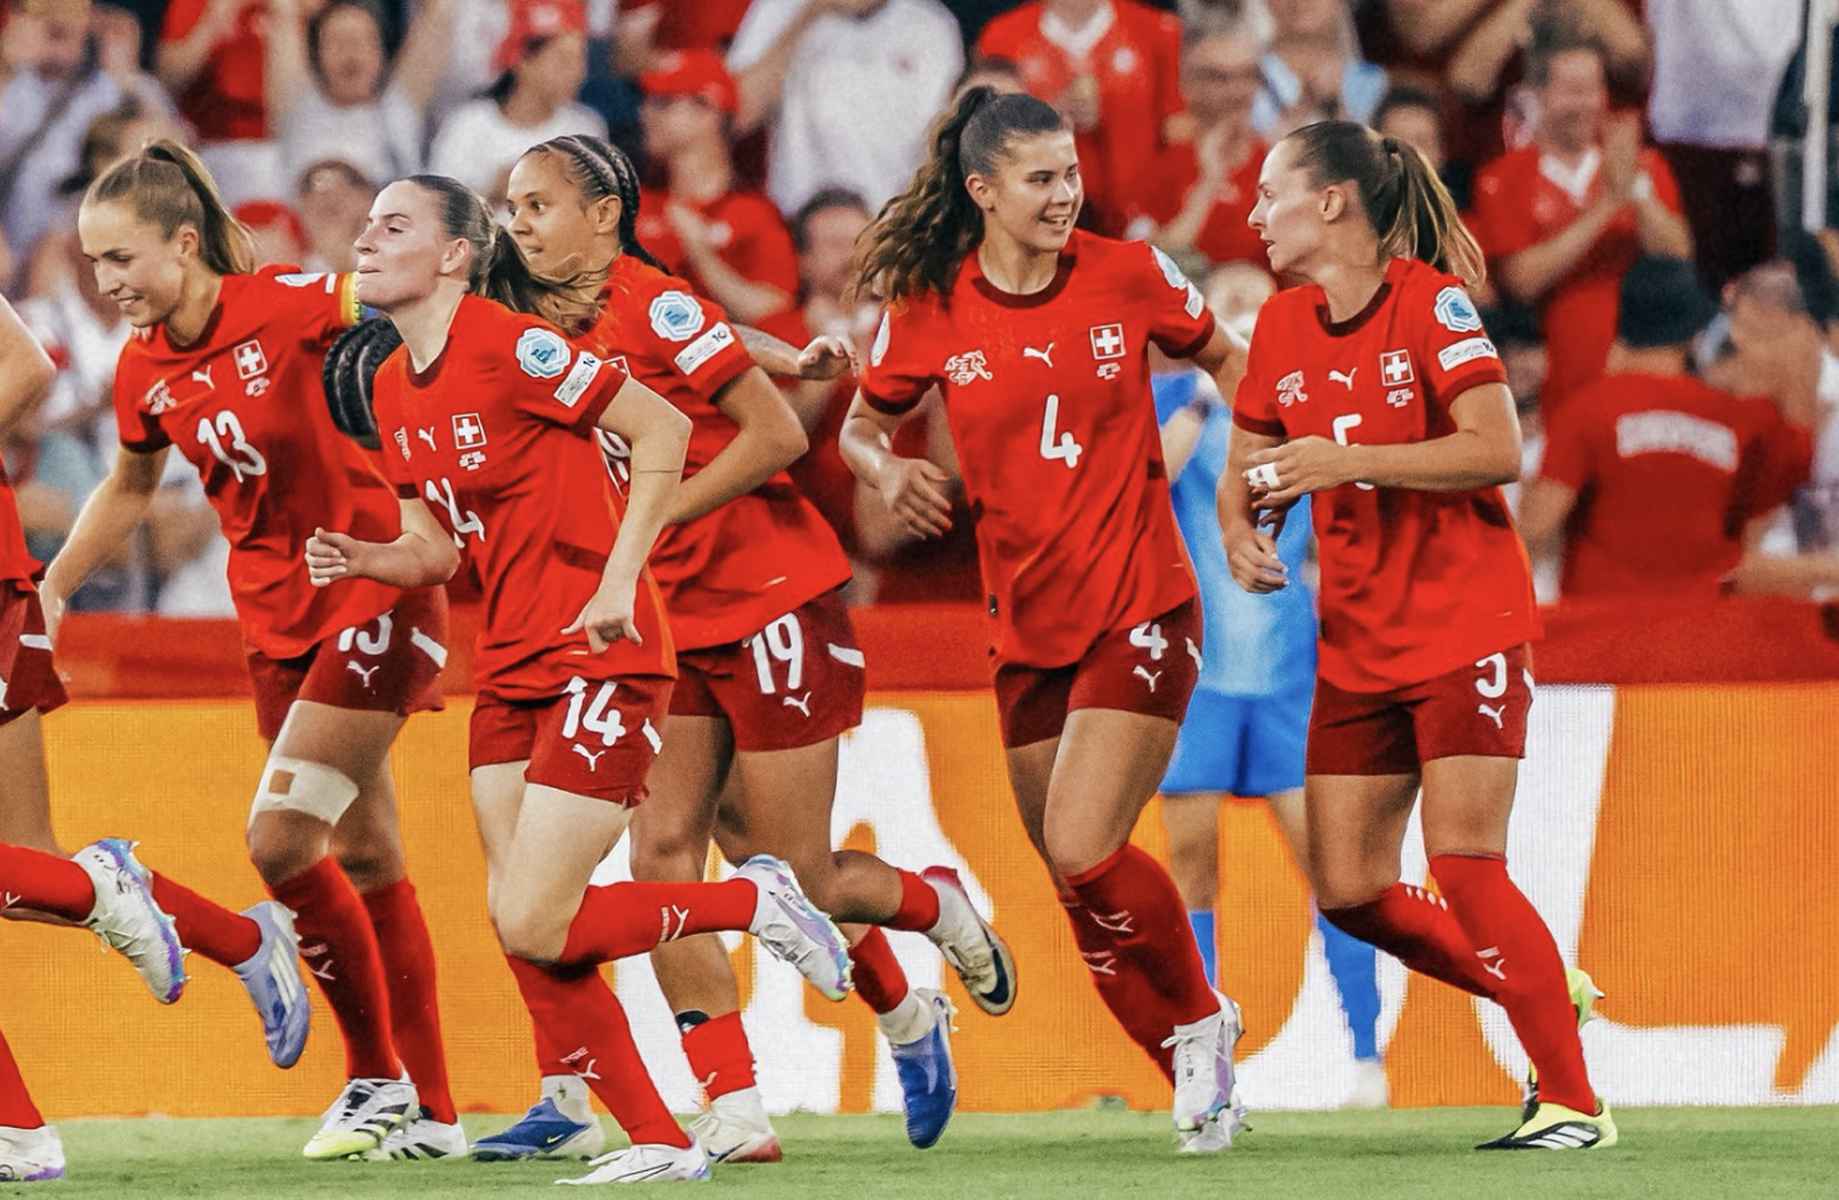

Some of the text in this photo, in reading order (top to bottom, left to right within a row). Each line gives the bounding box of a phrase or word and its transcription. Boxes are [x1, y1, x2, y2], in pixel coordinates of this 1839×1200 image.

[197, 410, 267, 483] 13
[1040, 394, 1083, 469] 4
[742, 612, 804, 695] 19
[1129, 621, 1169, 661] 4
[561, 676, 627, 747] 14
